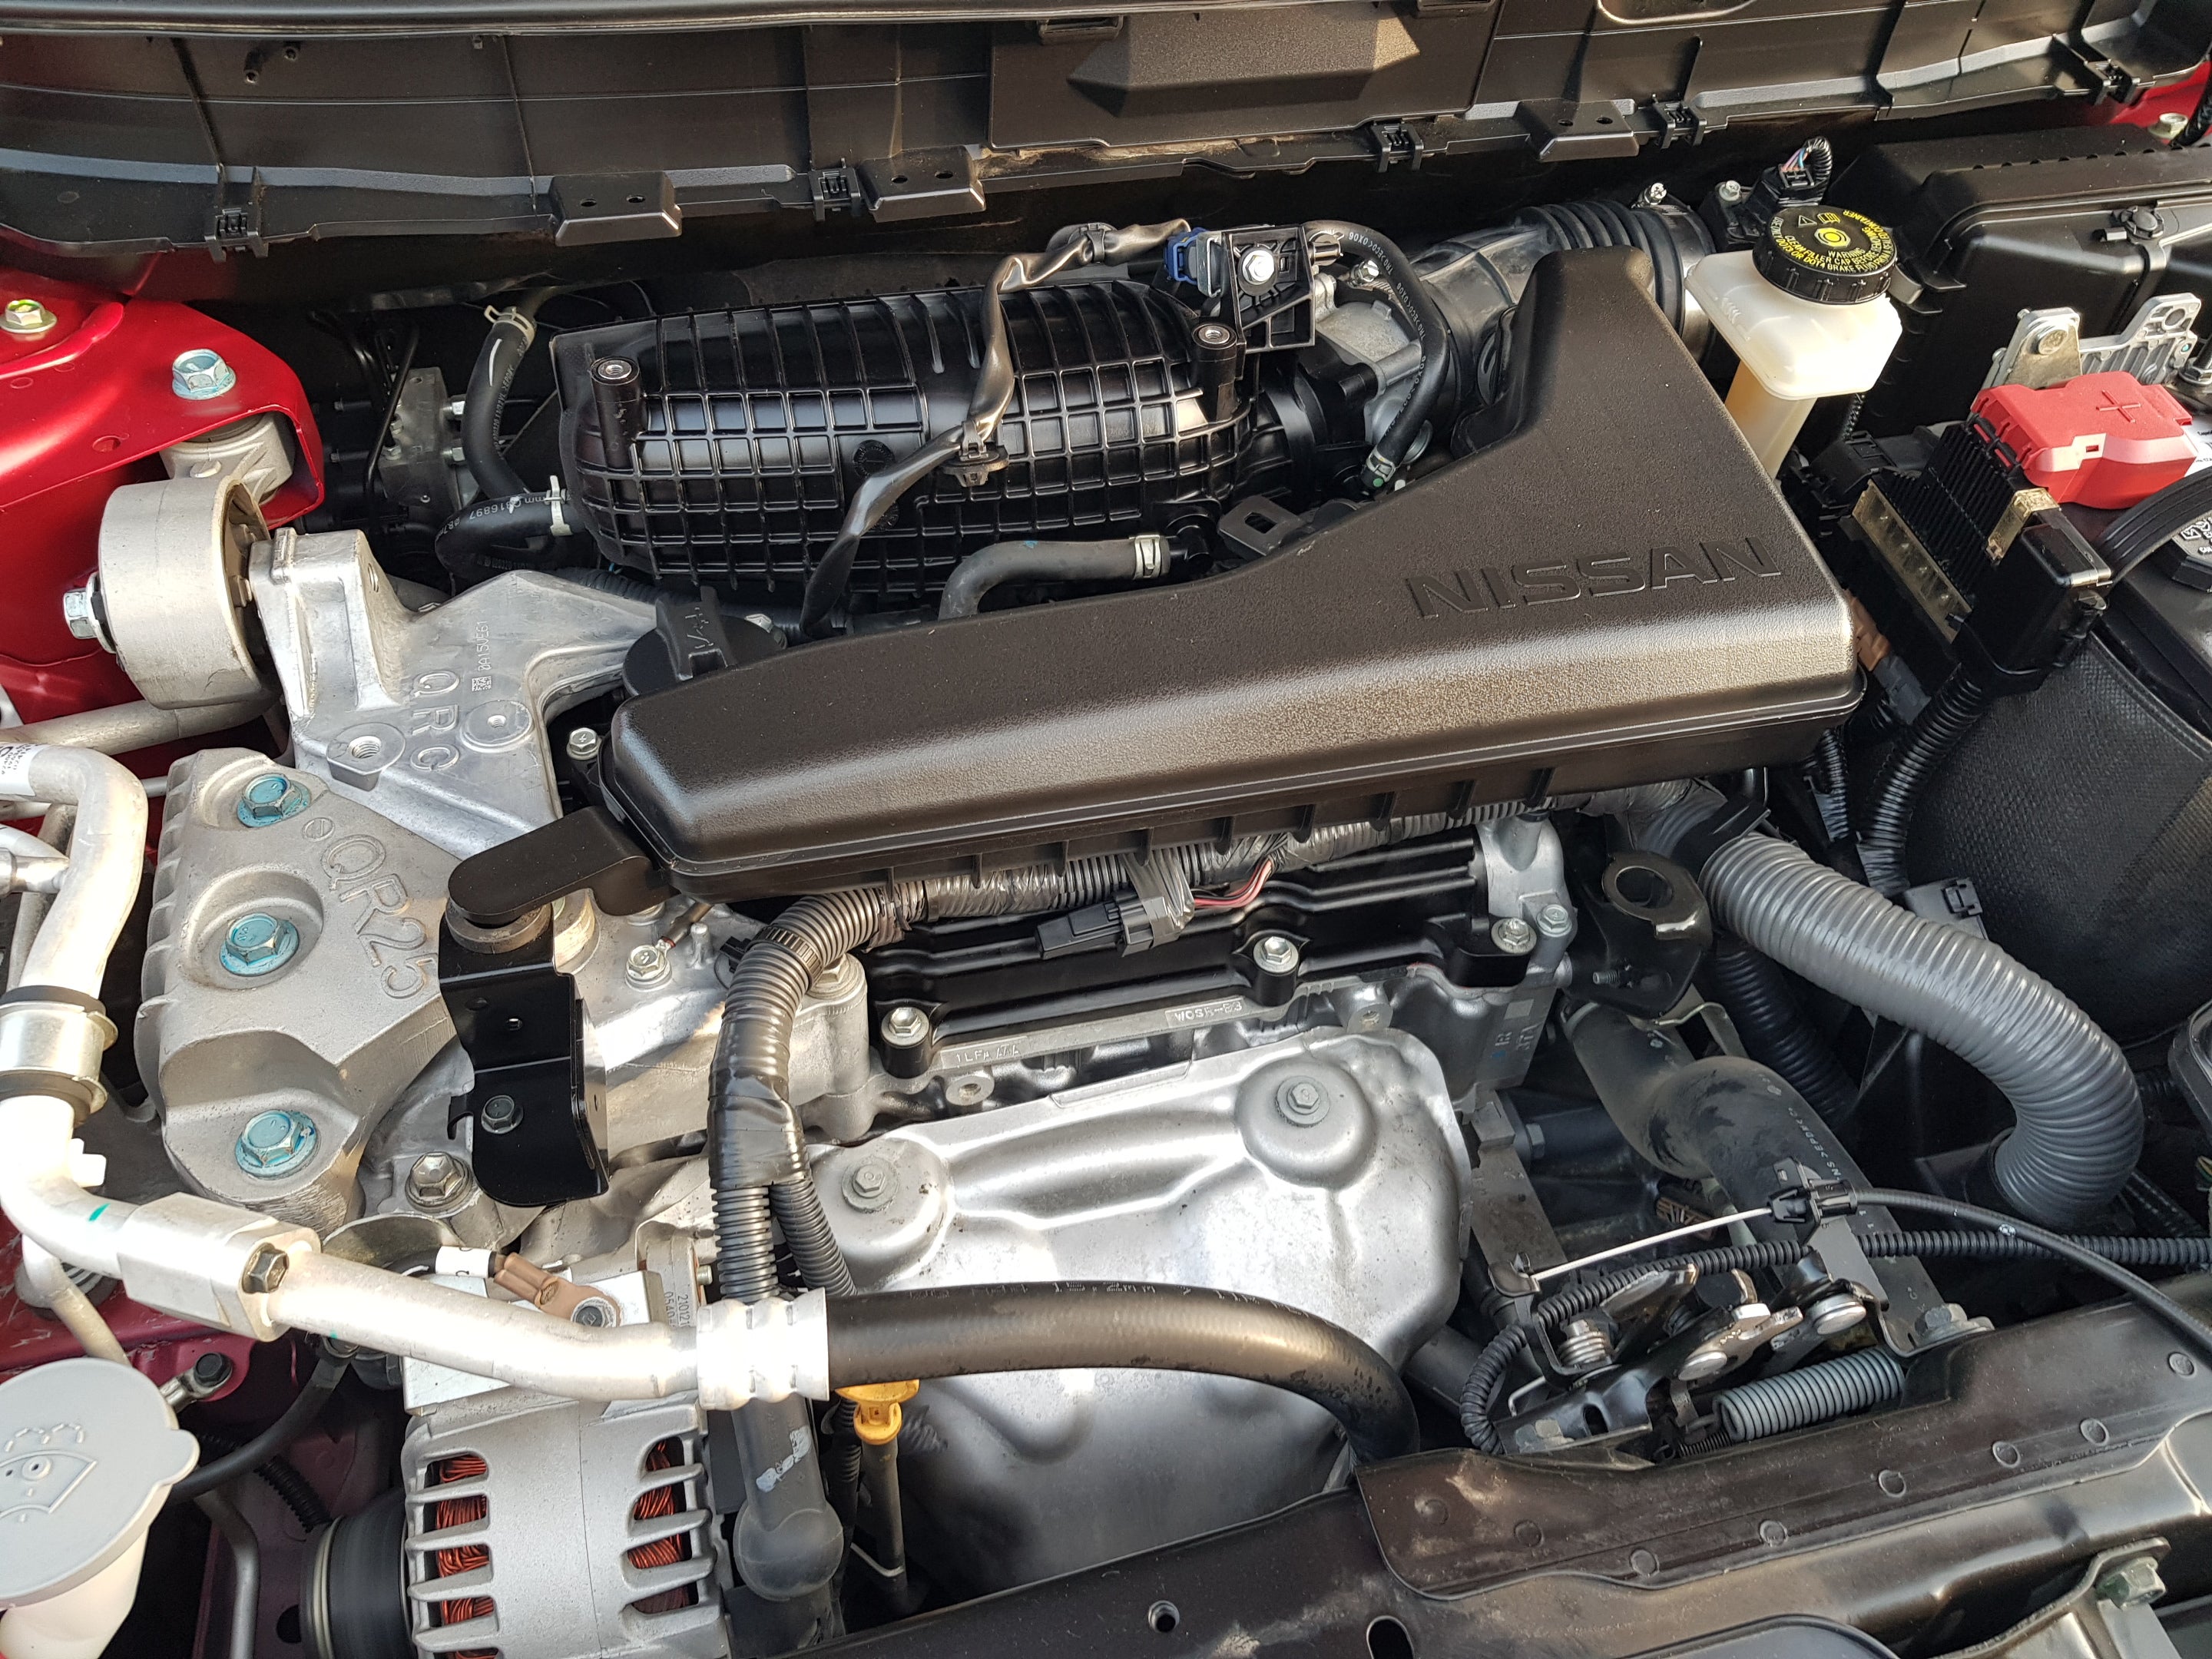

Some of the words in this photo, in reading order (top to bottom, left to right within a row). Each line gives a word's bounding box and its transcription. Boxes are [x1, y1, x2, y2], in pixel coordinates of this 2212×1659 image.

[1843, 210, 1884, 233] CONTAINER
[1785, 236, 1806, 253] CLEAN
[1861, 227, 1882, 253] REMOVING
[1791, 250, 1804, 260] OR
[1803, 250, 1832, 264] FILLER
[1828, 247, 1866, 259] WARNING
[1851, 250, 1880, 266] BEFORE
[1803, 256, 1826, 269] DOT4
[1827, 263, 1856, 273] BRAKE
[1834, 257, 1851, 266] CAP
[1854, 260, 1878, 273] FLUID
[1405, 537, 1782, 618] NISSAN
[320, 834, 438, 999] QR25
